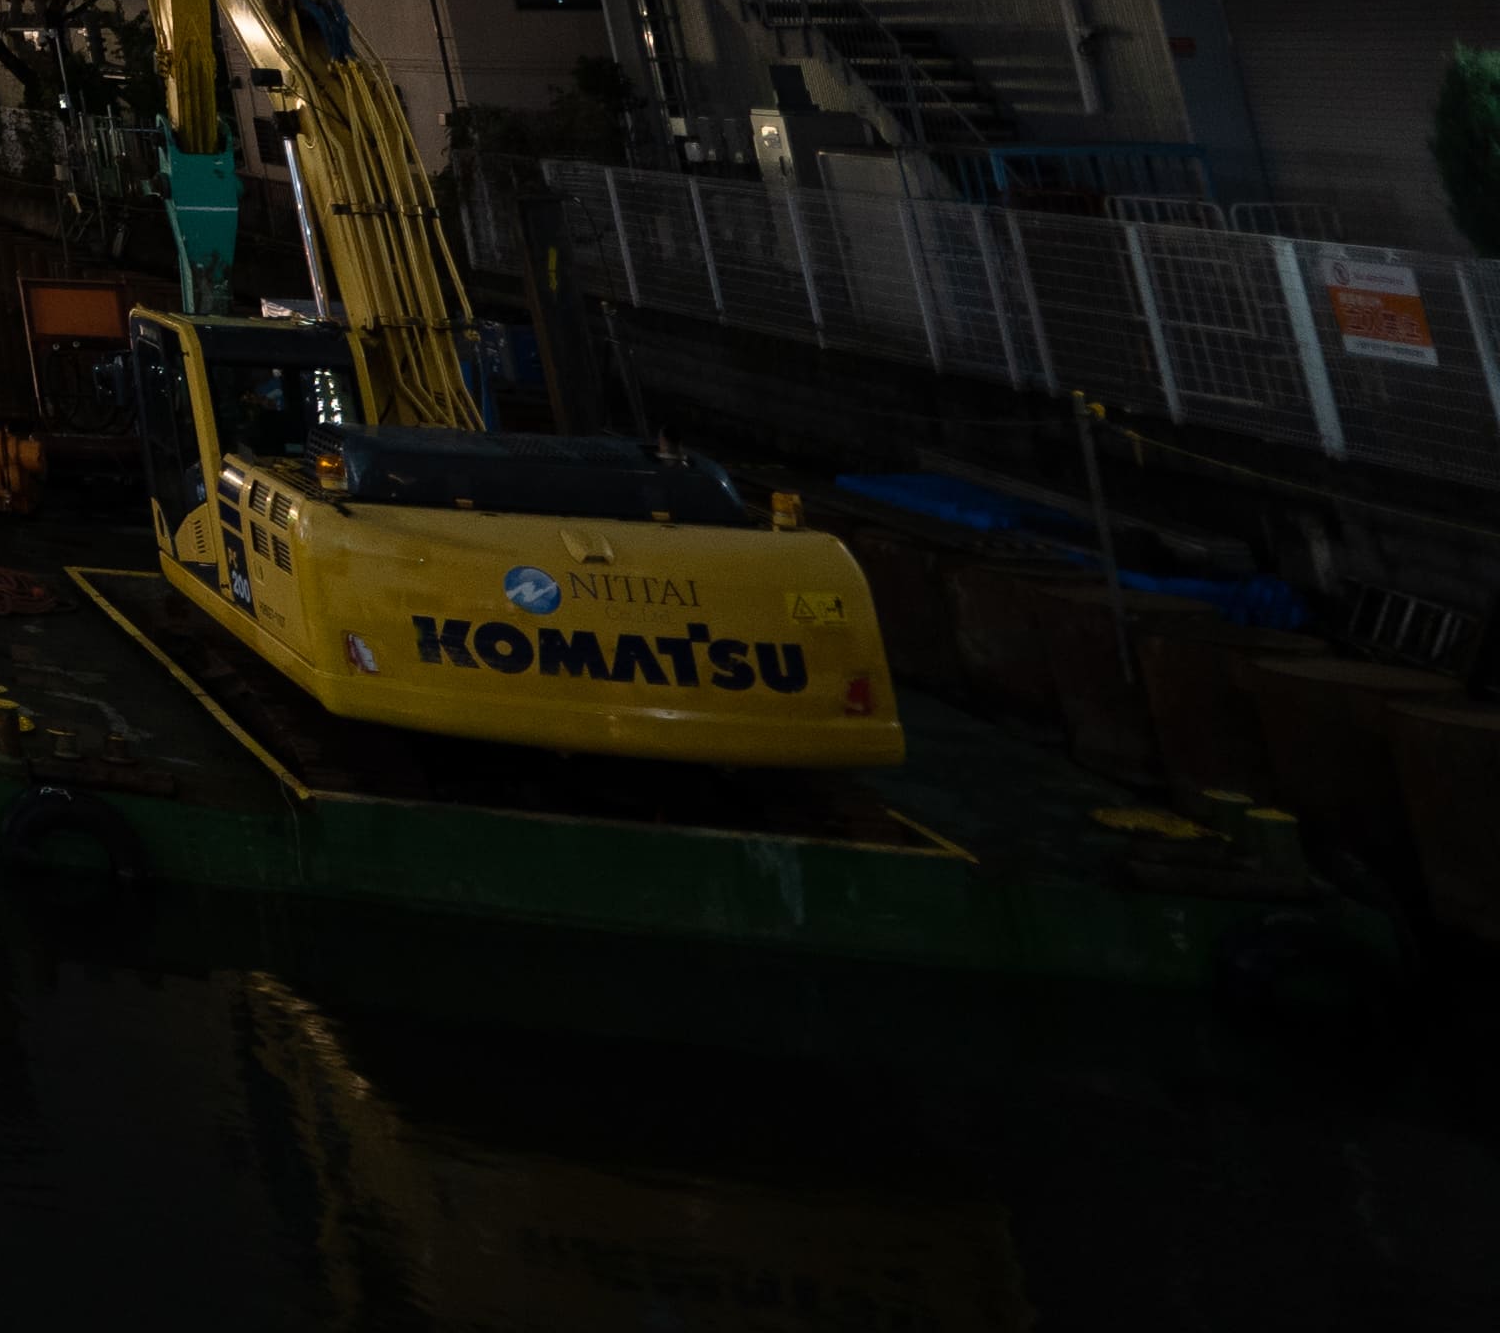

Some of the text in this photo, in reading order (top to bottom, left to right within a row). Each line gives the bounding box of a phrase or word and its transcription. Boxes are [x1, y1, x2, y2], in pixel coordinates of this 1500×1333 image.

[232, 569, 251, 604] 200
[567, 571, 701, 607] NITTAI
[411, 614, 808, 694] KOMATSU
